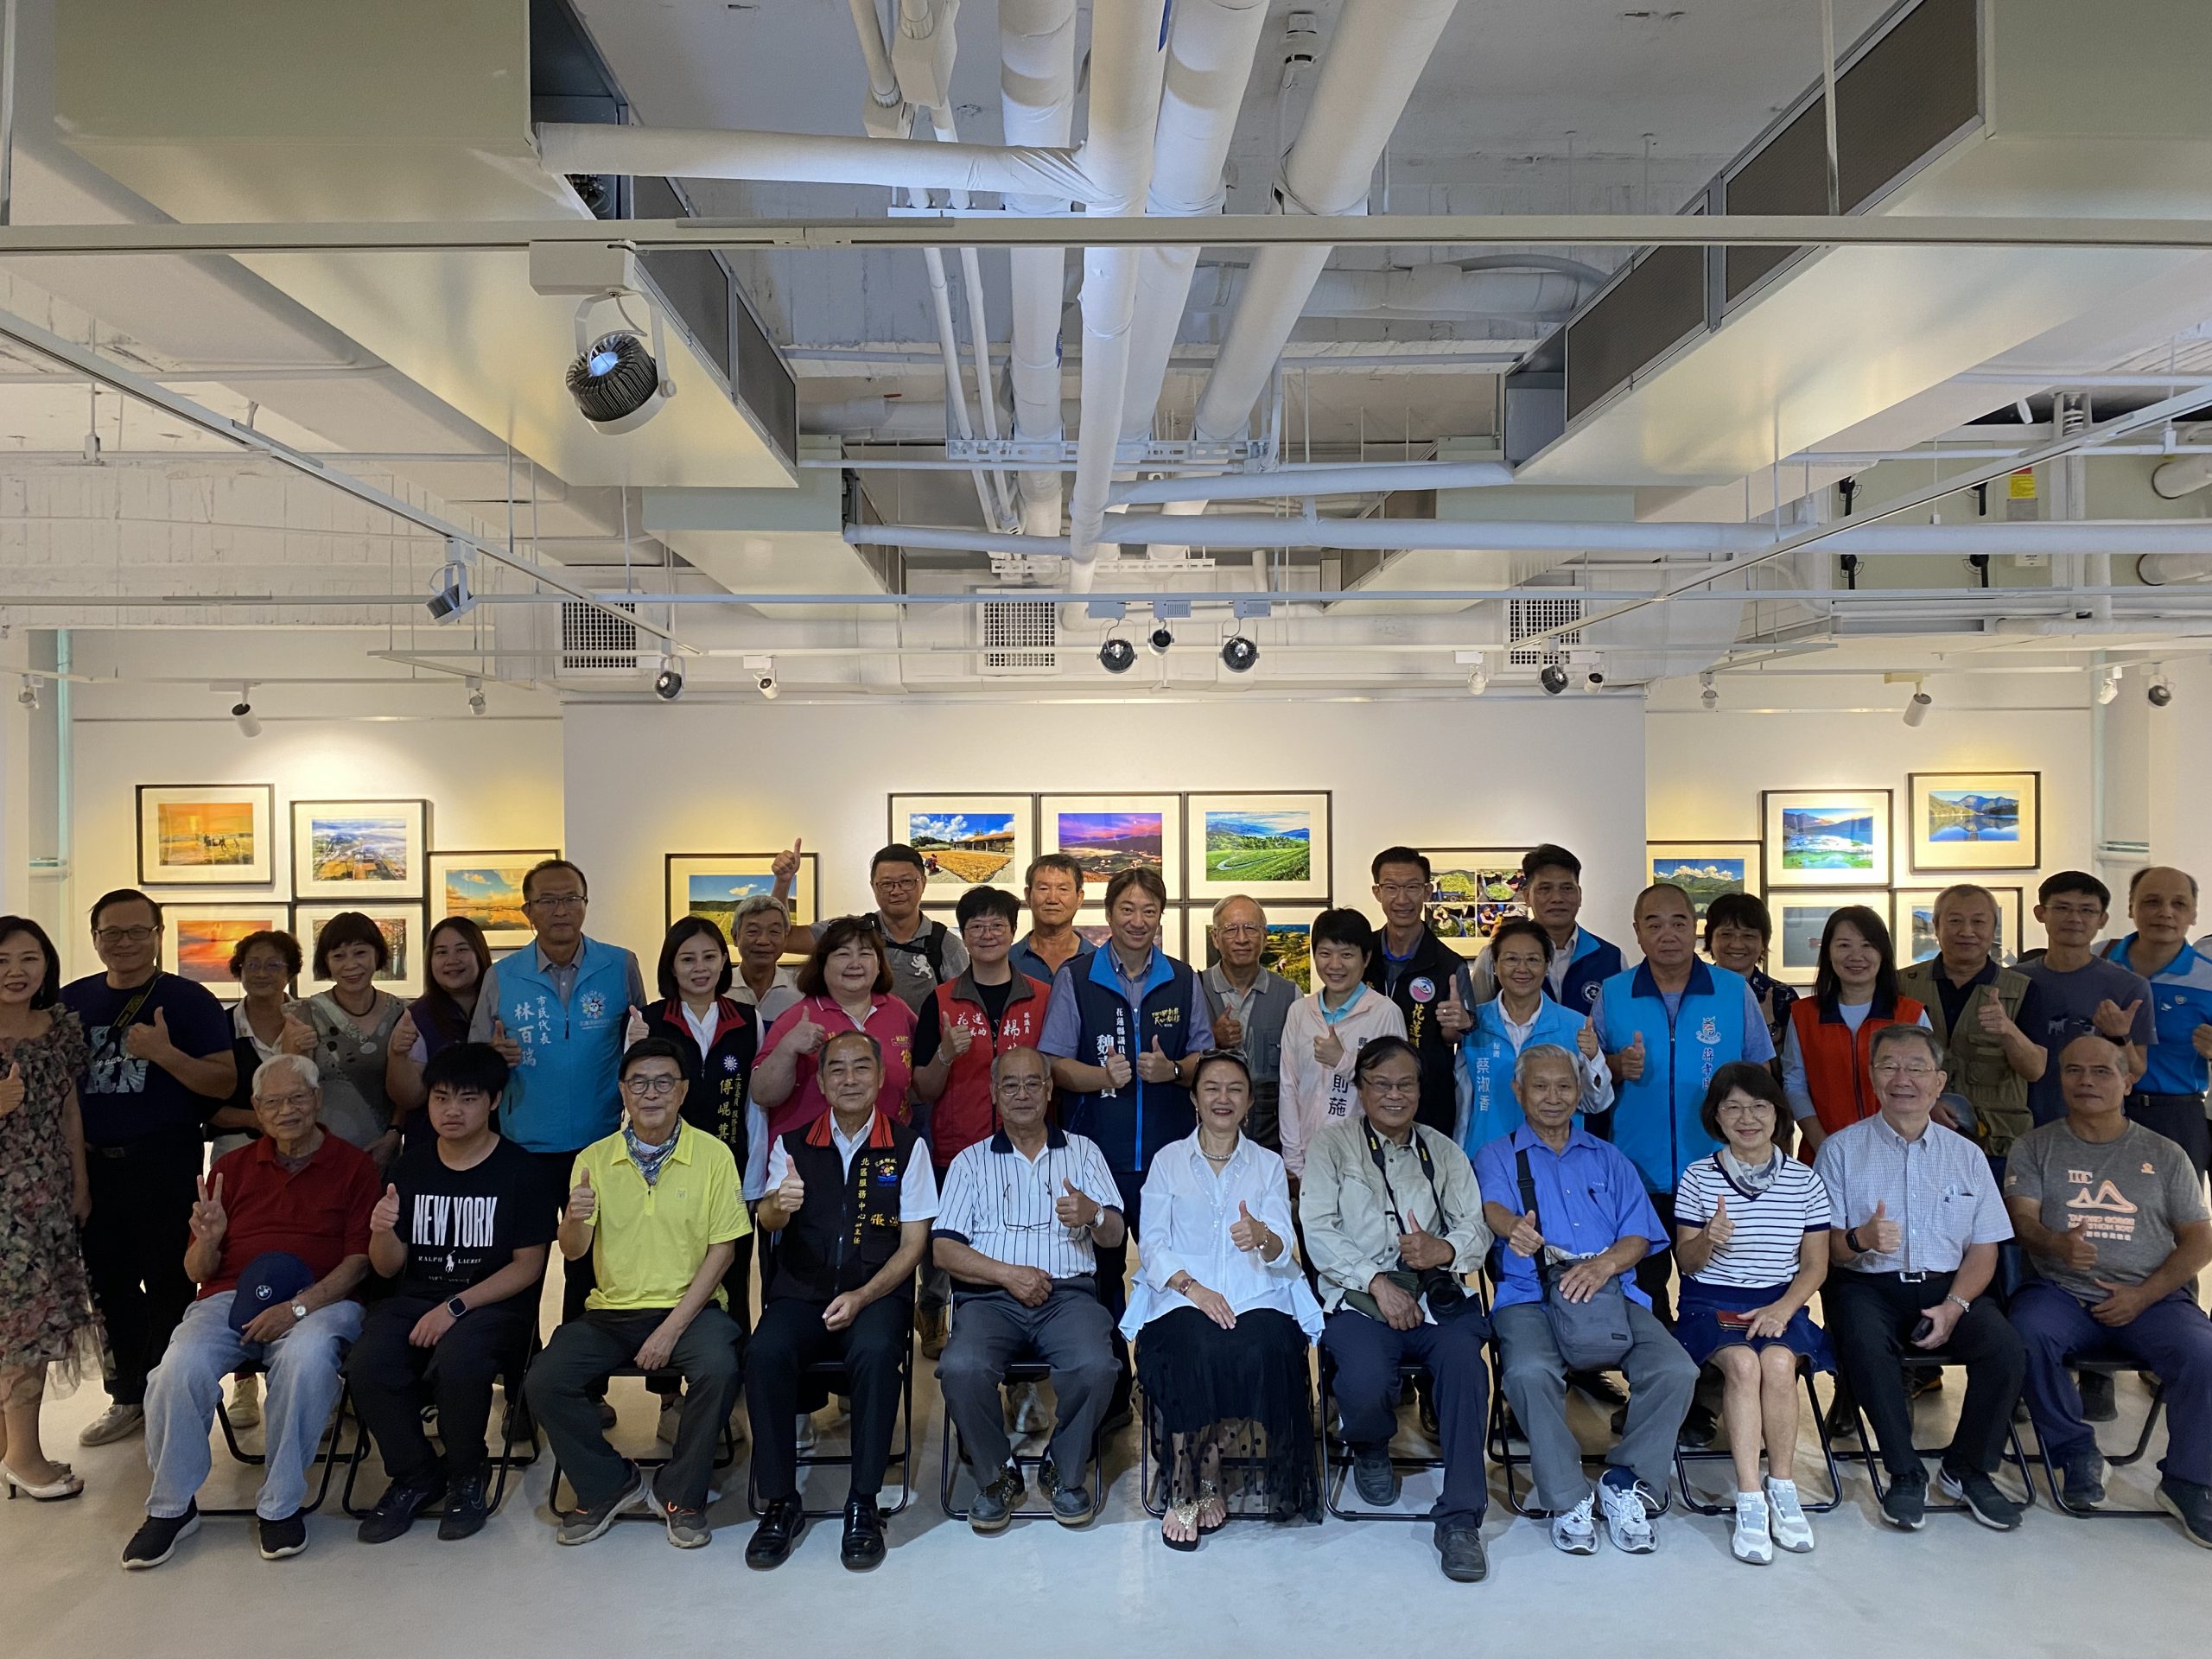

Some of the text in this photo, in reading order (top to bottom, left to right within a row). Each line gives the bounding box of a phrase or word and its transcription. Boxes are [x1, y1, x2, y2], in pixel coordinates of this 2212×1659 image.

[514, 1001, 537, 1066] 林百瑞
[536, 995, 552, 1045] 市民代表
[1002, 1019, 1020, 1050] 楊
[1476, 1057, 1491, 1111] 蔡淑香
[412, 1194, 498, 1248] NEW YORK
